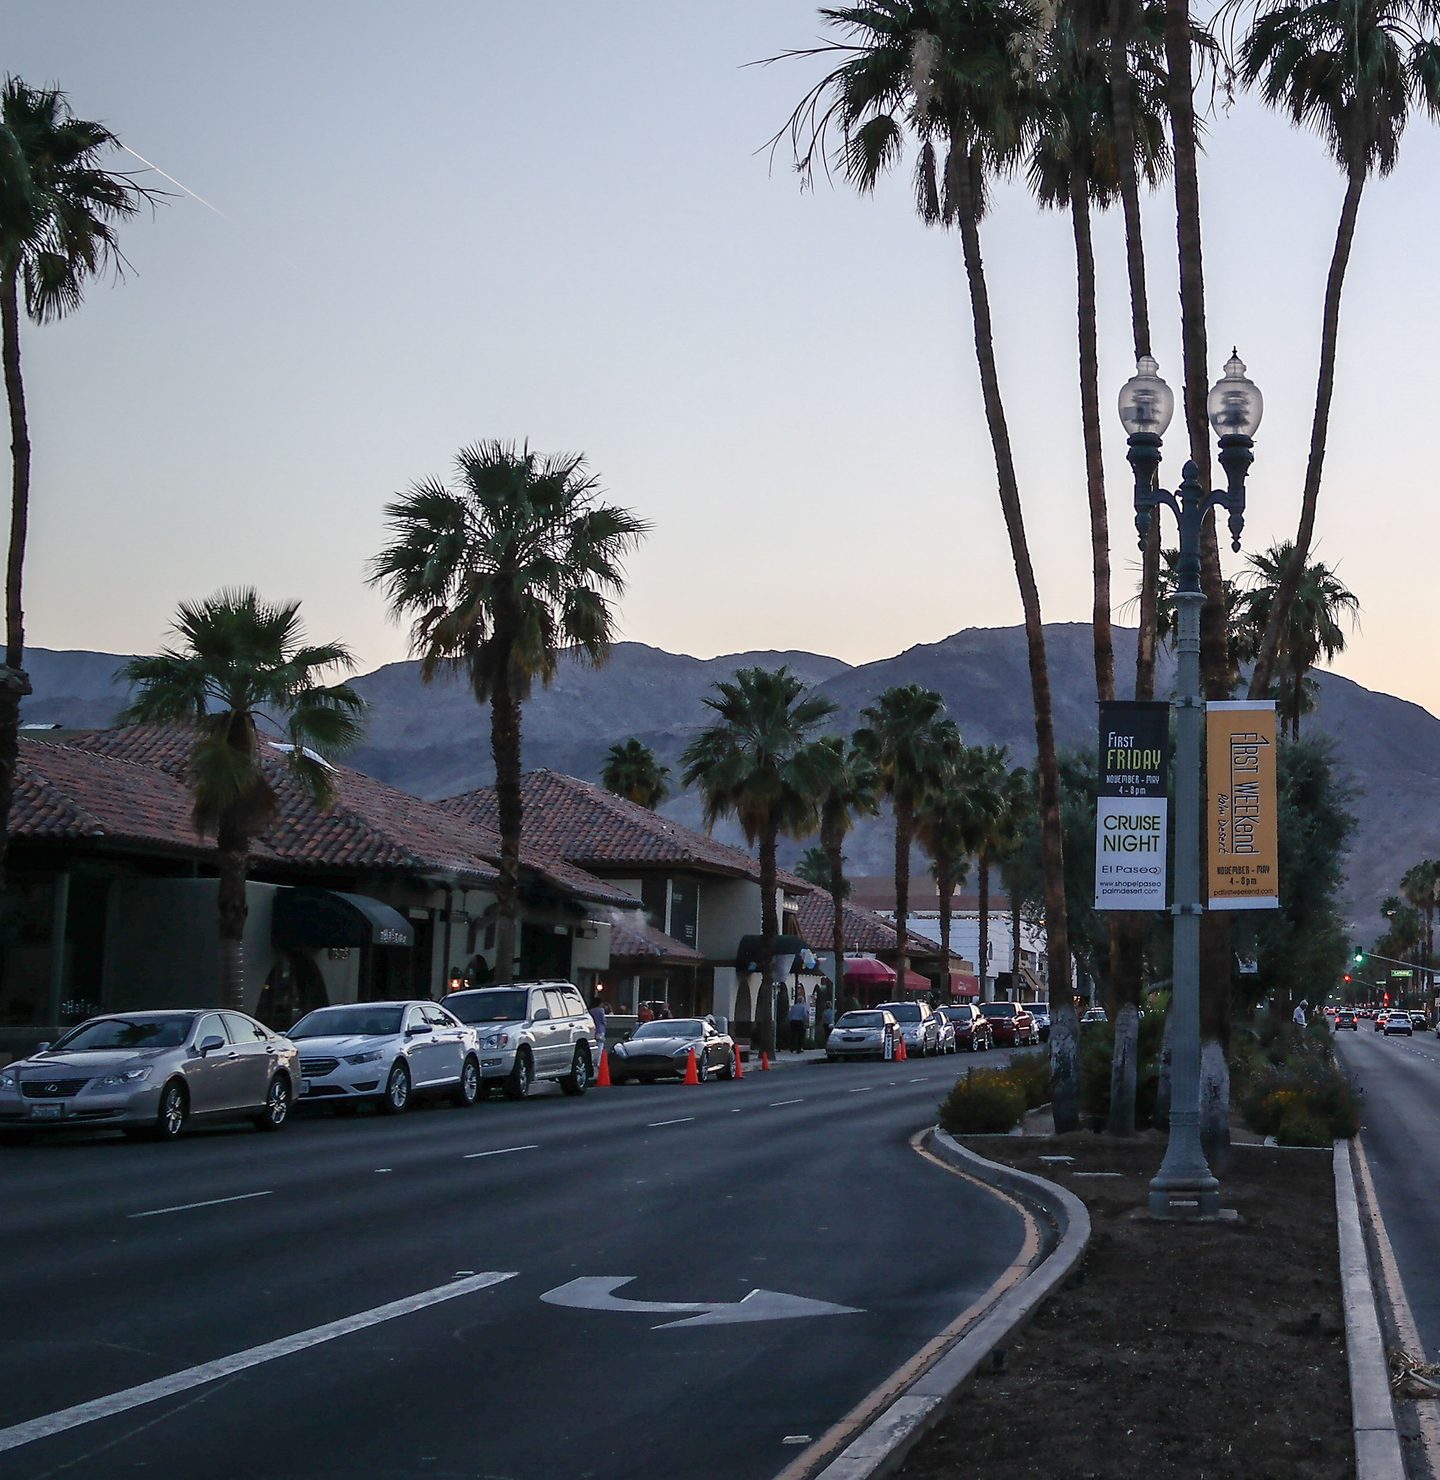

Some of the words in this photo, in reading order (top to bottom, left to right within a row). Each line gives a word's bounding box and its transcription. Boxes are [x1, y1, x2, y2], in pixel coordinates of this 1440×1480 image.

[1108, 731, 1134, 748] FIRST
[1107, 749, 1161, 770] FRIDAY
[1103, 815, 1161, 831] CRUISE
[1103, 834, 1160, 852] NIGHT
[1102, 865, 1112, 873] El
[1116, 865, 1159, 875] Paseo
